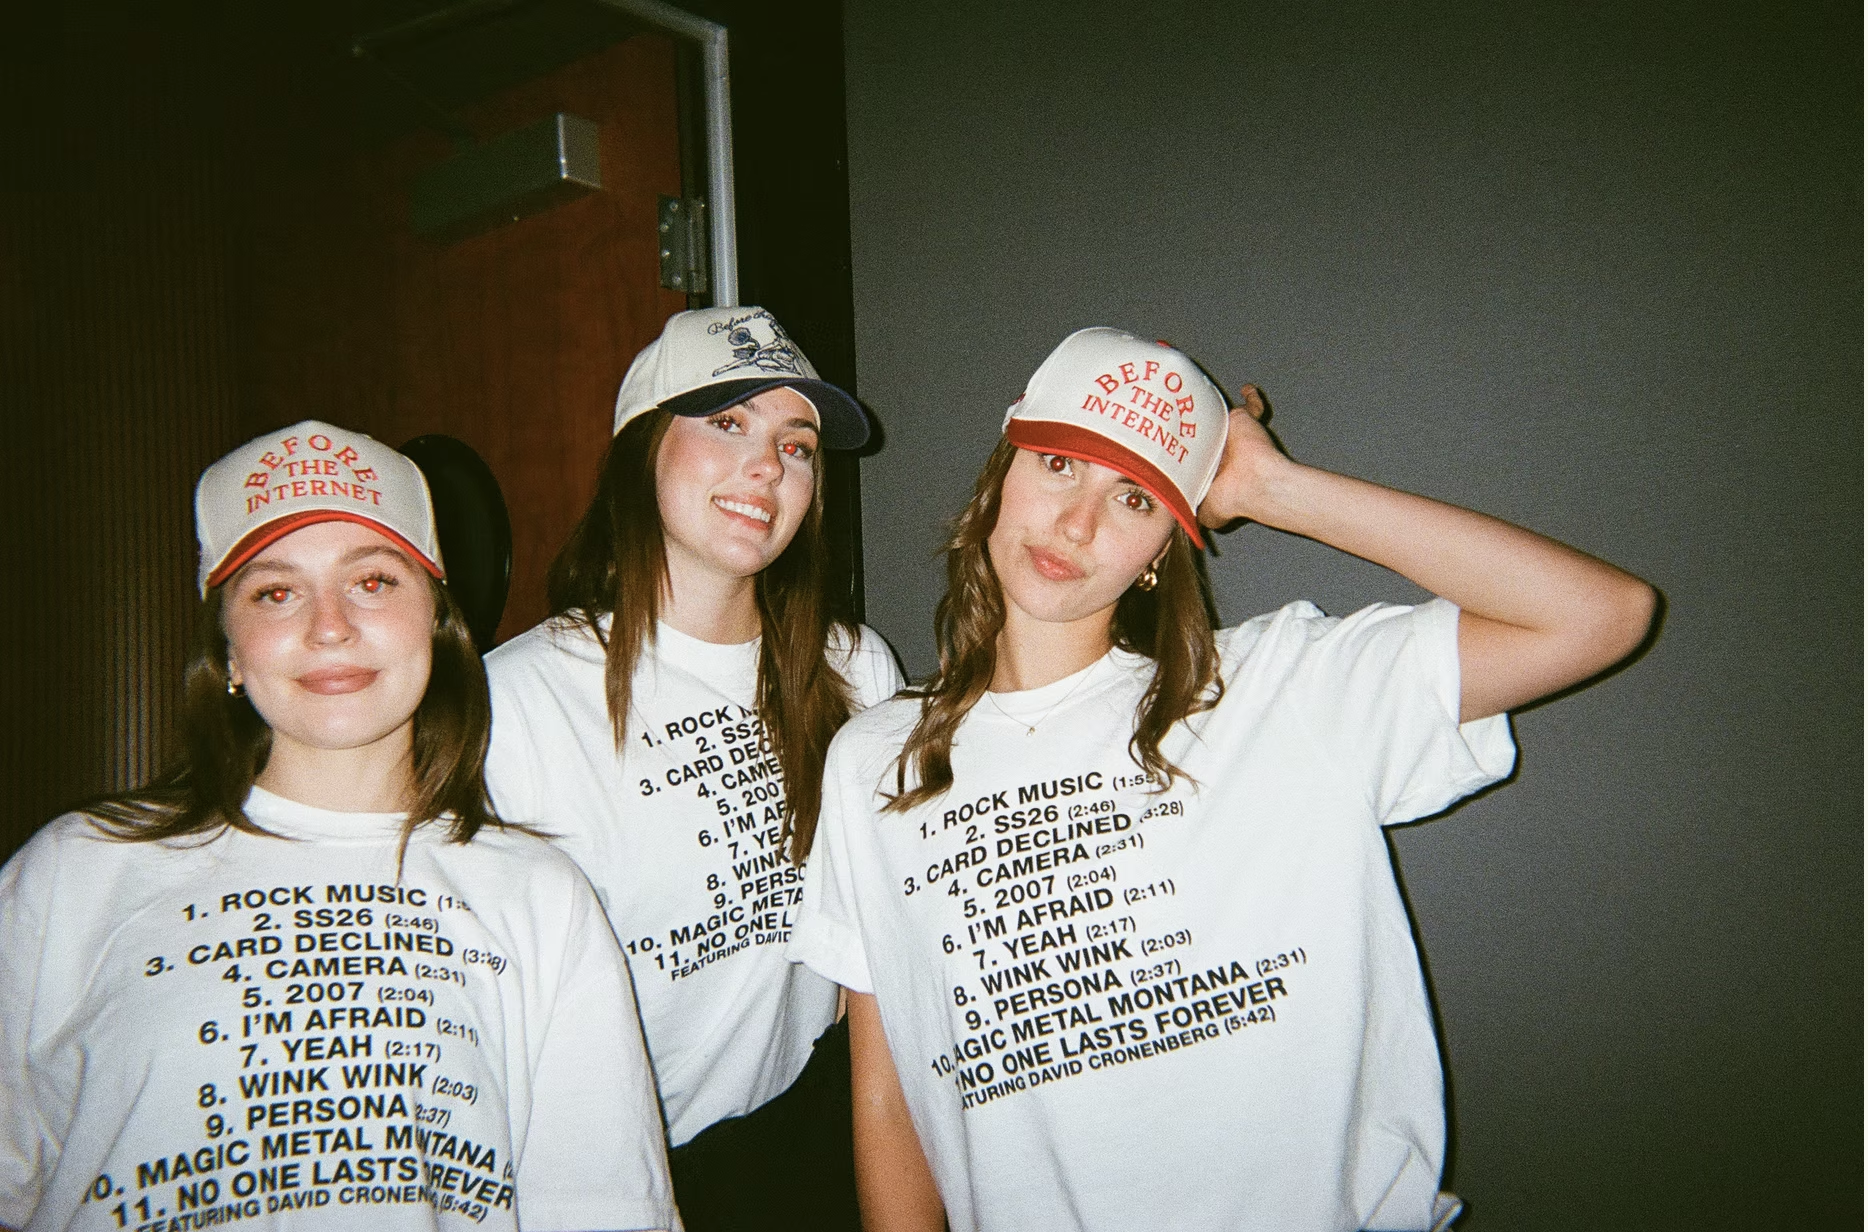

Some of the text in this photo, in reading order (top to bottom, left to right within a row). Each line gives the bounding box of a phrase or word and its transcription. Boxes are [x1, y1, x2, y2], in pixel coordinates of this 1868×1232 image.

[707, 316, 751, 335] Before
[1095, 361, 1196, 438] BEFORE
[1130, 386, 1174, 422] THE
[1081, 394, 1189, 464] INTERNET
[244, 434, 379, 489] BEFORE
[283, 460, 339, 477] THE
[246, 480, 382, 515] INTERNET
[642, 732, 662, 748] 1.
[666, 706, 733, 742] ROCK
[695, 736, 717, 754] 2.
[721, 720, 765, 745] SS2
[639, 755, 724, 796] 3. CARD
[697, 756, 784, 798] 4. CAME
[716, 798, 738, 816] 5.
[920, 771, 1161, 839] 1. ROCK MUSIC (1:55
[966, 800, 1116, 844] 2. SS26 (2:46)
[698, 829, 719, 847] 6.
[723, 812, 756, 838] I'M
[727, 841, 748, 860] 7.
[904, 801, 1185, 896] 3. CARD DECLINED 3:28)
[706, 850, 791, 891] 8. WINK
[713, 862, 808, 910] 9. PERSO
[948, 833, 1144, 897] 4. CAMERA (2:31)
[183, 904, 208, 921] 1.
[222, 886, 313, 912] ROCK
[327, 884, 427, 907] MUSIC
[964, 866, 1116, 918] 5. 2007 (2:04)
[253, 908, 439, 933] 2. SS26 (2:46)
[627, 887, 803, 955] 10. MAGIC META
[942, 878, 1175, 954] 6. I'M AFRAID (2:11)
[145, 956, 174, 977] 3.
[188, 936, 282, 965] CARD
[295, 932, 454, 957] DECLINED
[654, 951, 690, 970] 11.
[696, 932, 726, 958] NO
[735, 912, 778, 940] ONE
[670, 938, 750, 981] FEATURING
[973, 916, 1136, 970] 7. YEAH (2:17)
[222, 956, 467, 987] 4. CAMERA (2:31)
[953, 929, 1192, 1007] 8. WINK WINK (2:03)
[243, 981, 434, 1008] 5. 2007 (2:04)
[931, 948, 1306, 1077] 10. AGIC METAL MONTANA (2:31)
[965, 959, 1181, 1031] 9. PERSONA (2:37)
[199, 1006, 479, 1047] 6. I'M AFRAID (2:11)
[960, 977, 1289, 1092] NO ONE LASTS FOREVER
[240, 1034, 441, 1068] 7. YEAH (2:17)
[961, 1005, 1276, 1112] ATURING DAVID CRONENBERG (5:42)
[199, 1063, 478, 1108] 8. WINK WINK (2:03)
[206, 1094, 451, 1139] 9. PERSONA 2:37)
[137, 1139, 250, 1190] MAGIC
[262, 1126, 373, 1161] METAL
[385, 1125, 496, 1173] MNTANA
[111, 1196, 166, 1228] 11.
[178, 1174, 220, 1212] NO
[231, 1163, 300, 1198] ONE
[312, 1156, 418, 1186] LASTS
[423, 1160, 515, 1214] REVER
[267, 1189, 331, 1214] DAVID
[338, 1185, 438, 1210] CRONEN
[439, 1194, 488, 1223] (5:42)
